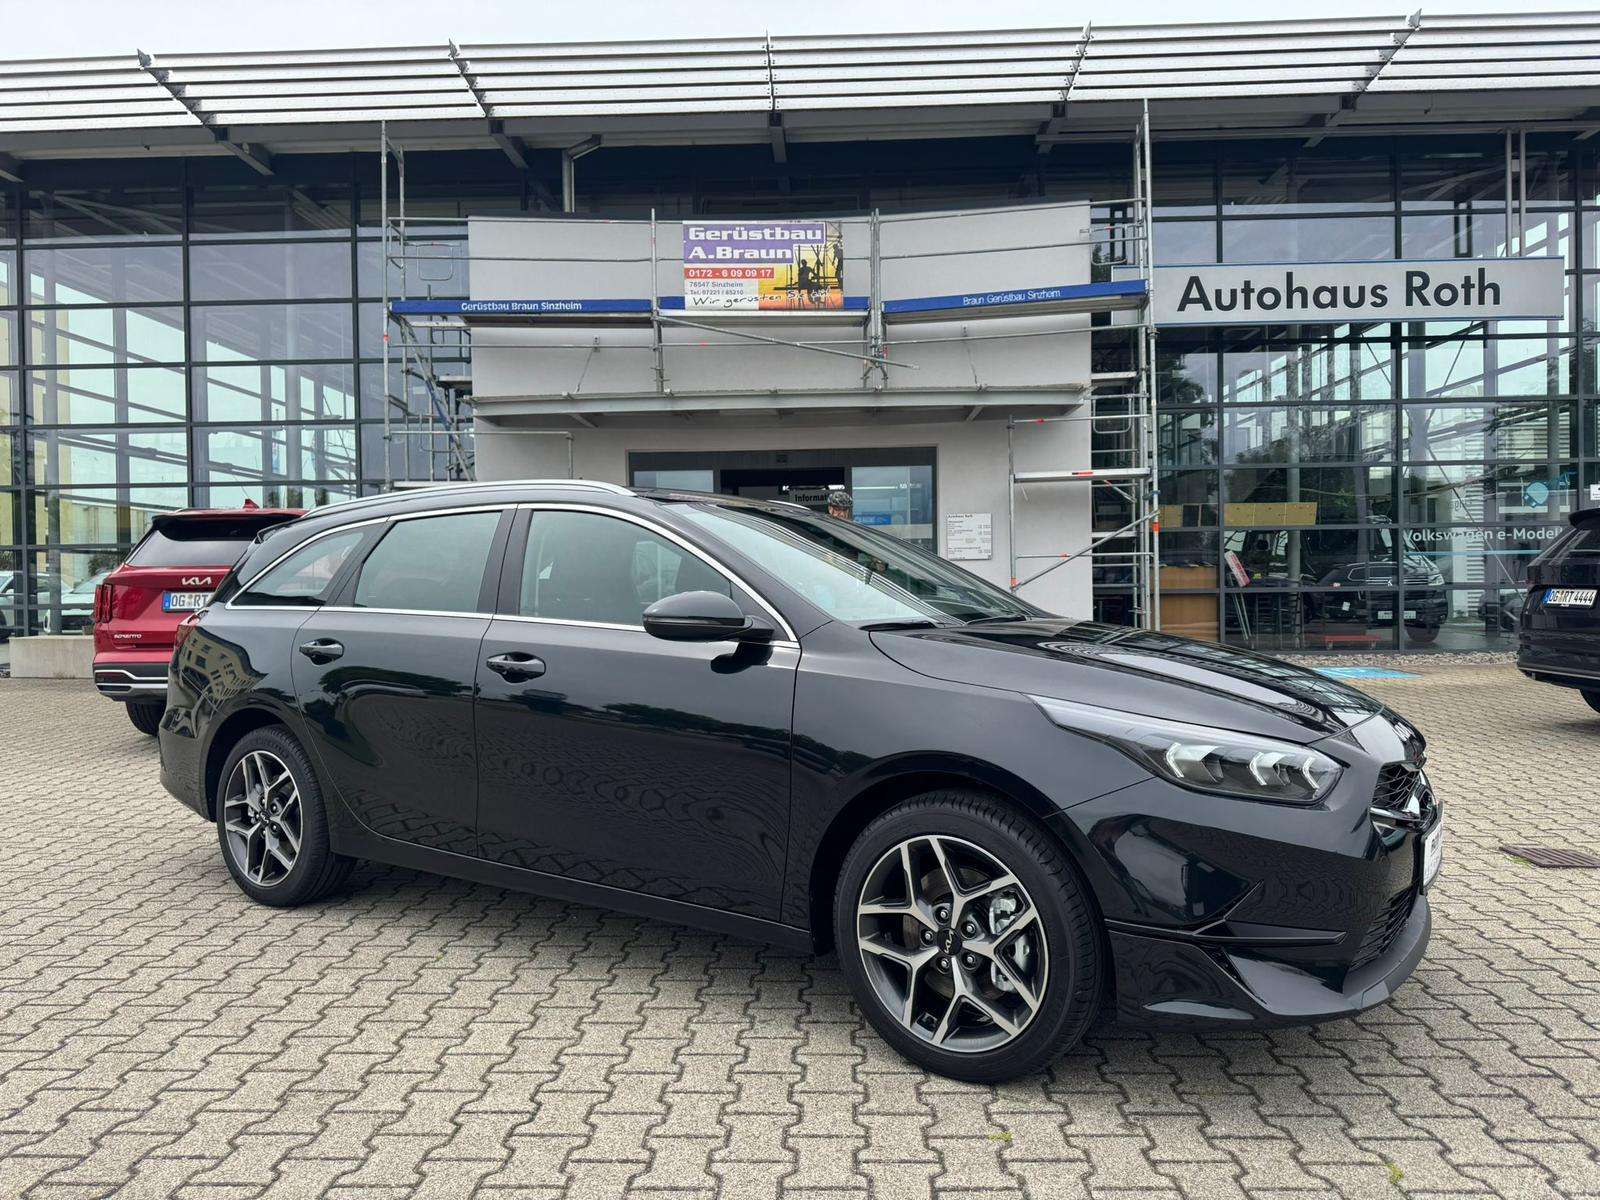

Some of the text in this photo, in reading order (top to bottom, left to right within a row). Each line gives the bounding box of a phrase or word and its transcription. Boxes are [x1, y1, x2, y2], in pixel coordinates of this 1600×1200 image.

[688, 227, 822, 240] Gerüstbau
[688, 246, 793, 259] A.Braun
[688, 269, 713, 277] 0172
[721, 269, 728, 277] 6
[730, 269, 742, 277] 09
[760, 269, 771, 277] 17
[1177, 267, 1500, 312] Autohaus Roth
[693, 296, 720, 306] Wir
[963, 289, 1061, 305] Braun Gerüstbau Sinzheim
[461, 301, 582, 310] Gerüstbau Braun Sinzheim
[1404, 528, 1493, 543] Volkswagen
[171, 594, 208, 607] OG RT
